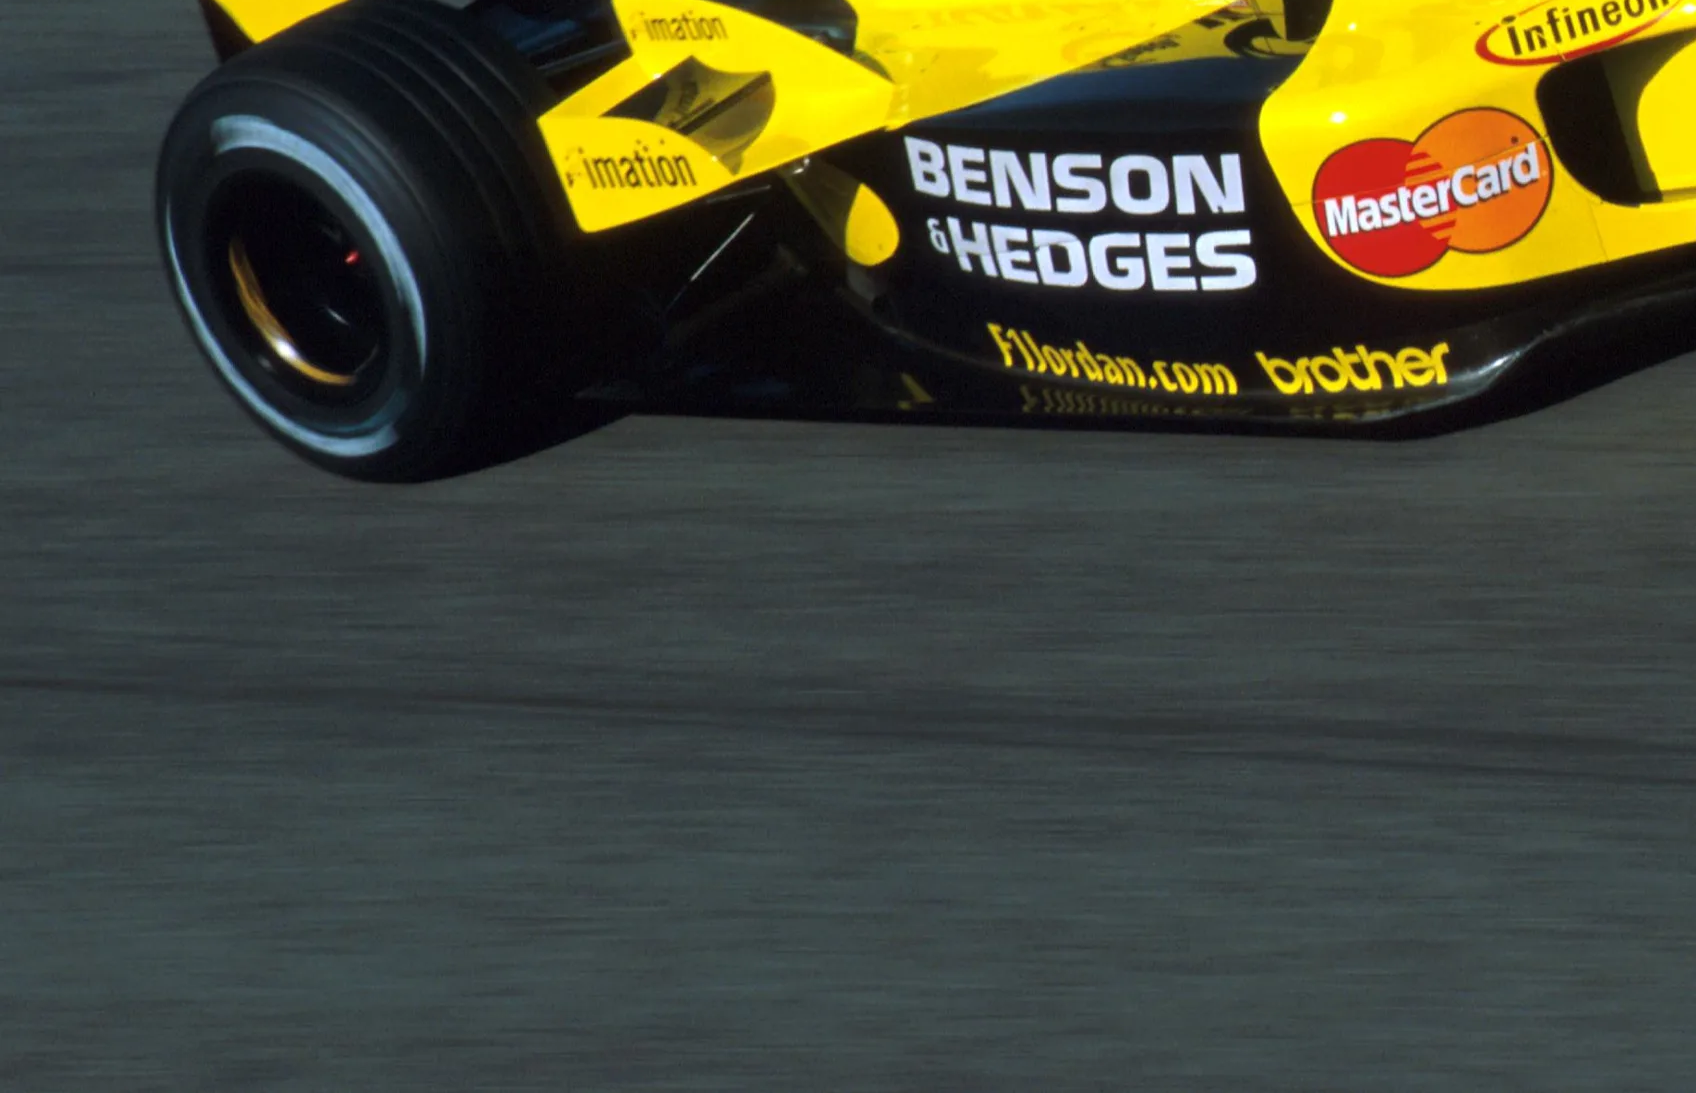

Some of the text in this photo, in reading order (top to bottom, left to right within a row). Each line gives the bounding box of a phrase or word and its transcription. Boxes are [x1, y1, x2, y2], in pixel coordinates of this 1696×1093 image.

[644, 11, 729, 41] imation
[583, 139, 697, 190] imation
[903, 136, 1245, 214] BENSON
[1324, 143, 1541, 238] MasterCard
[987, 322, 1239, 396] F1Jordan.com
[1255, 342, 1450, 395] brother
